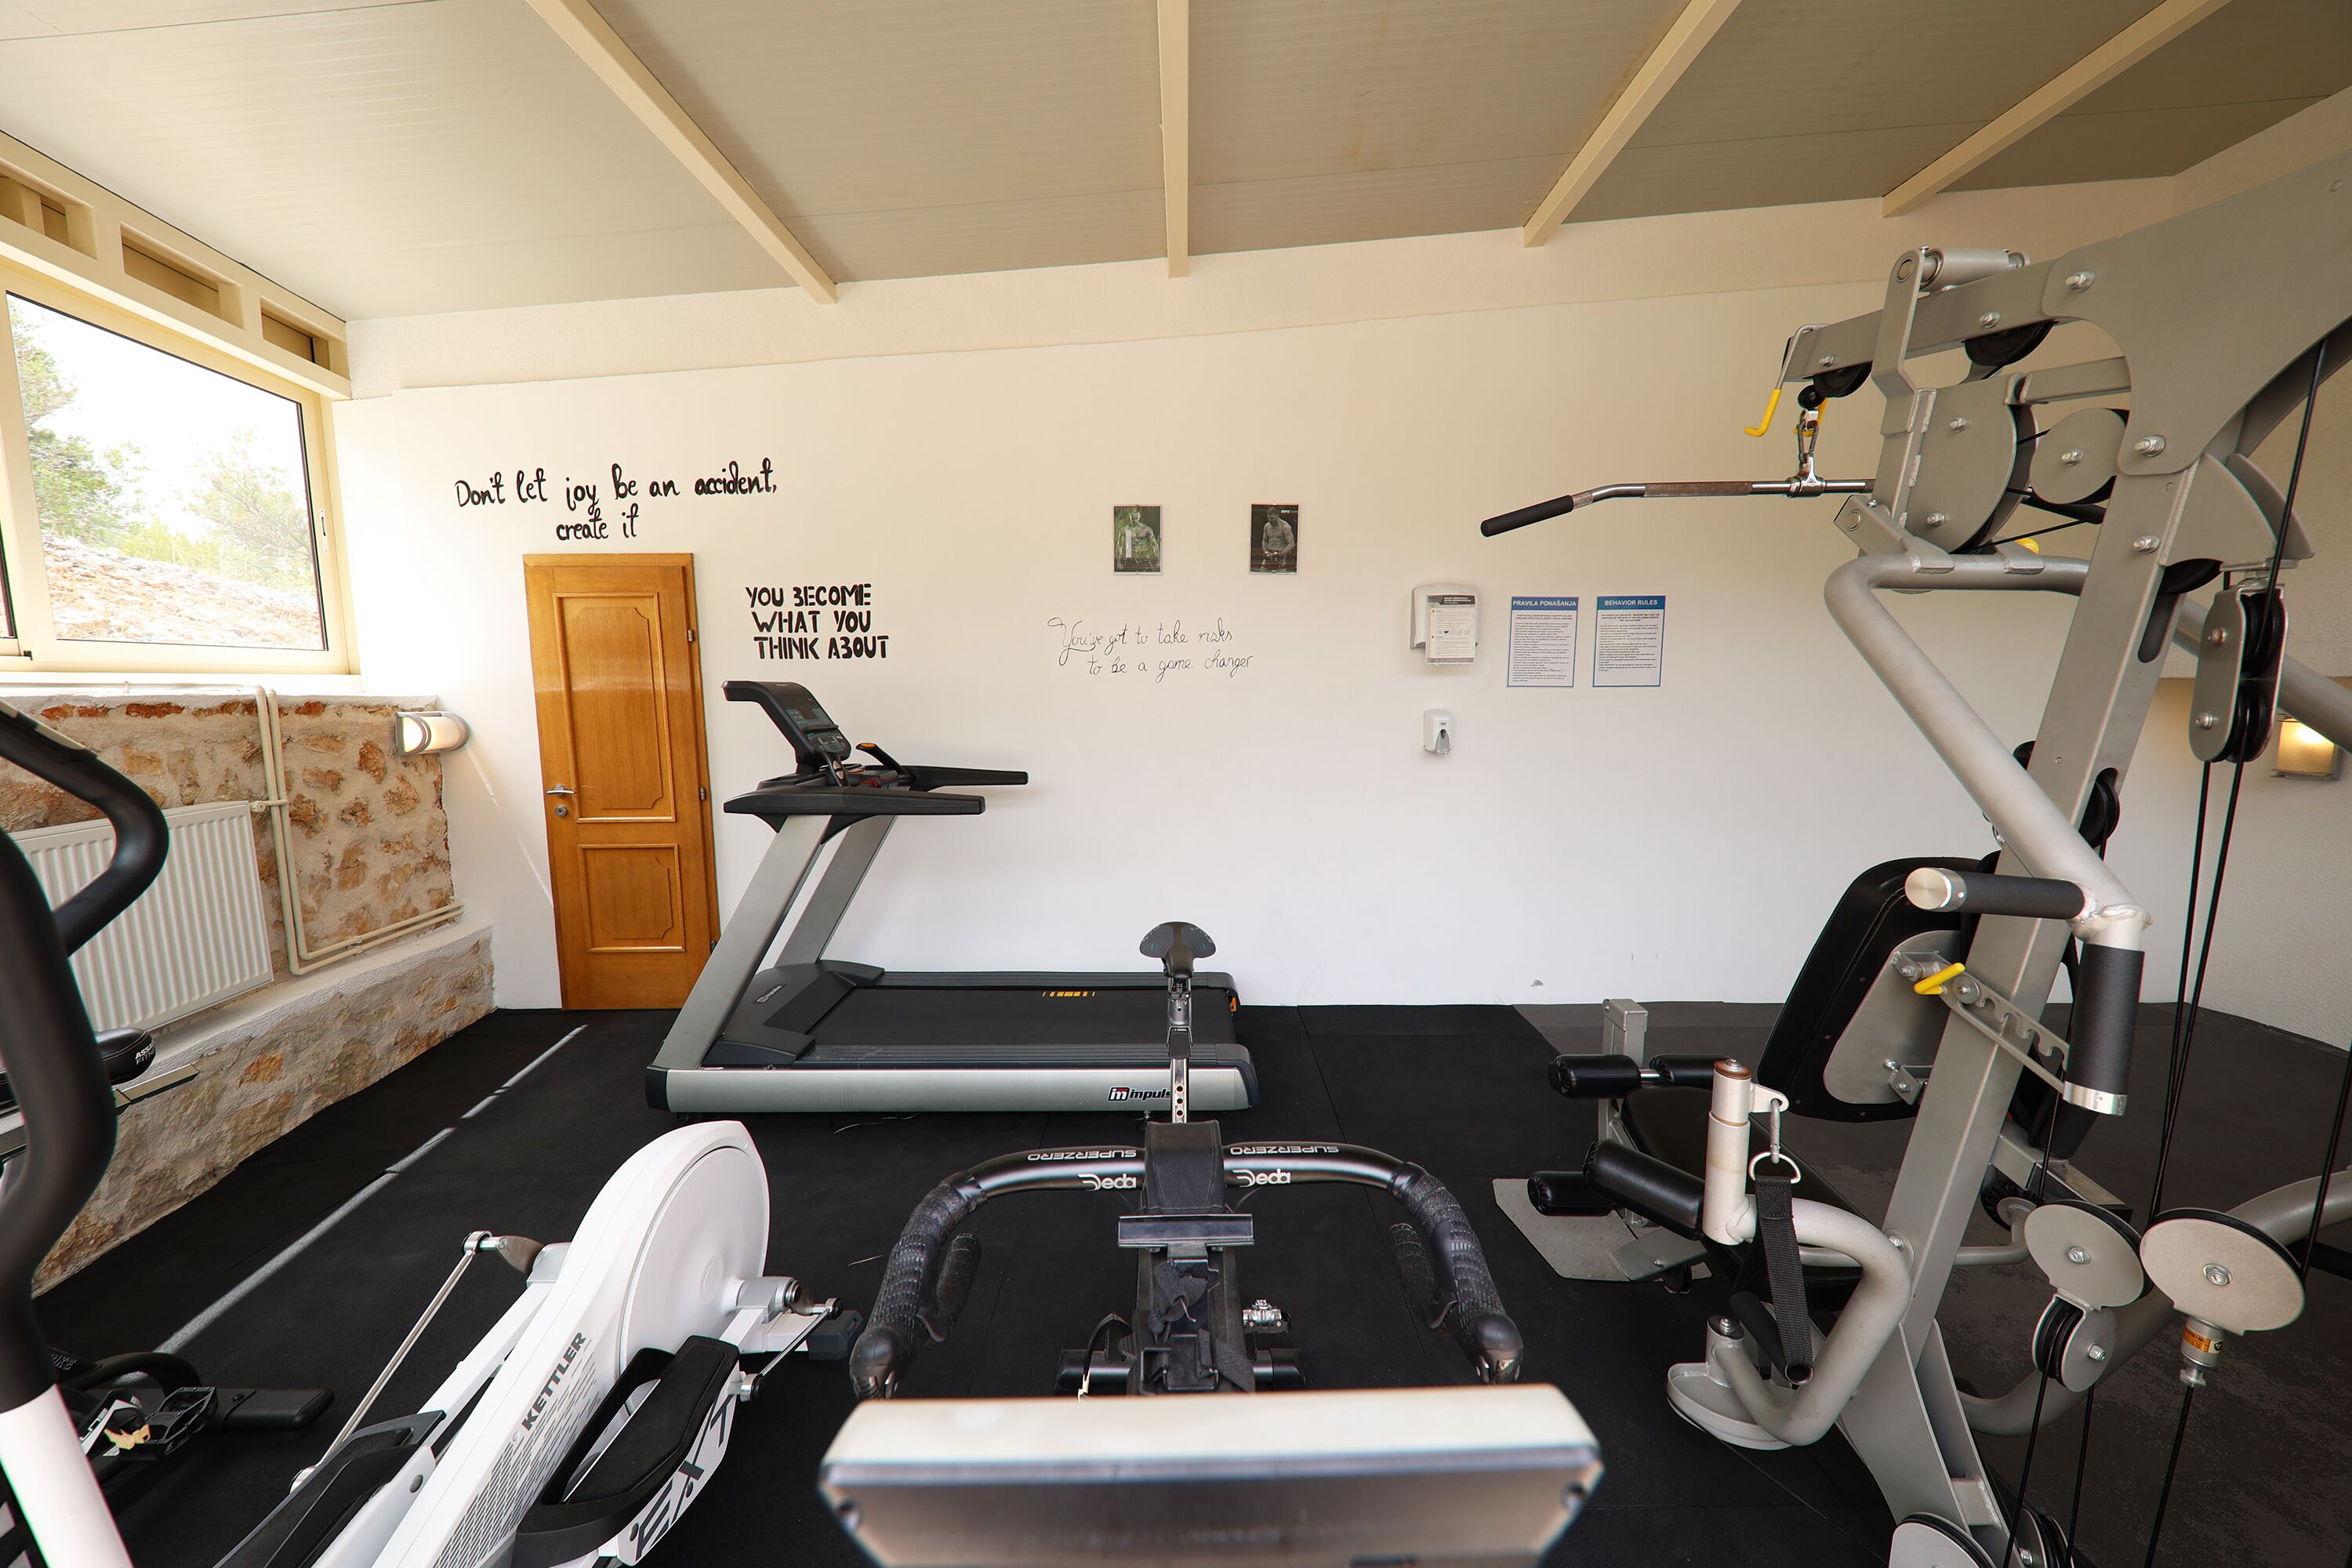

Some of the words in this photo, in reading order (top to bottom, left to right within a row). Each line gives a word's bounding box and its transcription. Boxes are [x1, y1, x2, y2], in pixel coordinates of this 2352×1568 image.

[454, 472, 506, 508] Don't
[516, 468, 548, 503] let
[565, 477, 601, 514] joy
[612, 463, 638, 500] be
[649, 480, 681, 497] an
[695, 458, 777, 495] accident,
[556, 508, 609, 541] create
[745, 586, 785, 608] YOU
[793, 583, 872, 608] BECOME
[751, 611, 821, 633] WHAT
[833, 611, 871, 633] YOU
[753, 637, 820, 659] THINK
[827, 635, 890, 659] ABOUT
[1104, 622, 1128, 655] got
[1134, 626, 1149, 644] to
[1156, 619, 1189, 644] take
[1198, 617, 1232, 643] risks
[1087, 655, 1103, 676] to
[1111, 656, 1127, 673] be
[1138, 662, 1148, 672] a
[1155, 657, 1193, 684] game
[1203, 649, 1254, 677] changer
[1130, 1089, 1171, 1101] impuls
[1027, 1149, 1137, 1161] SUPERZERO
[1229, 1145, 1340, 1156] SUPERZERO
[521, 1332, 586, 1432] KETTLER
